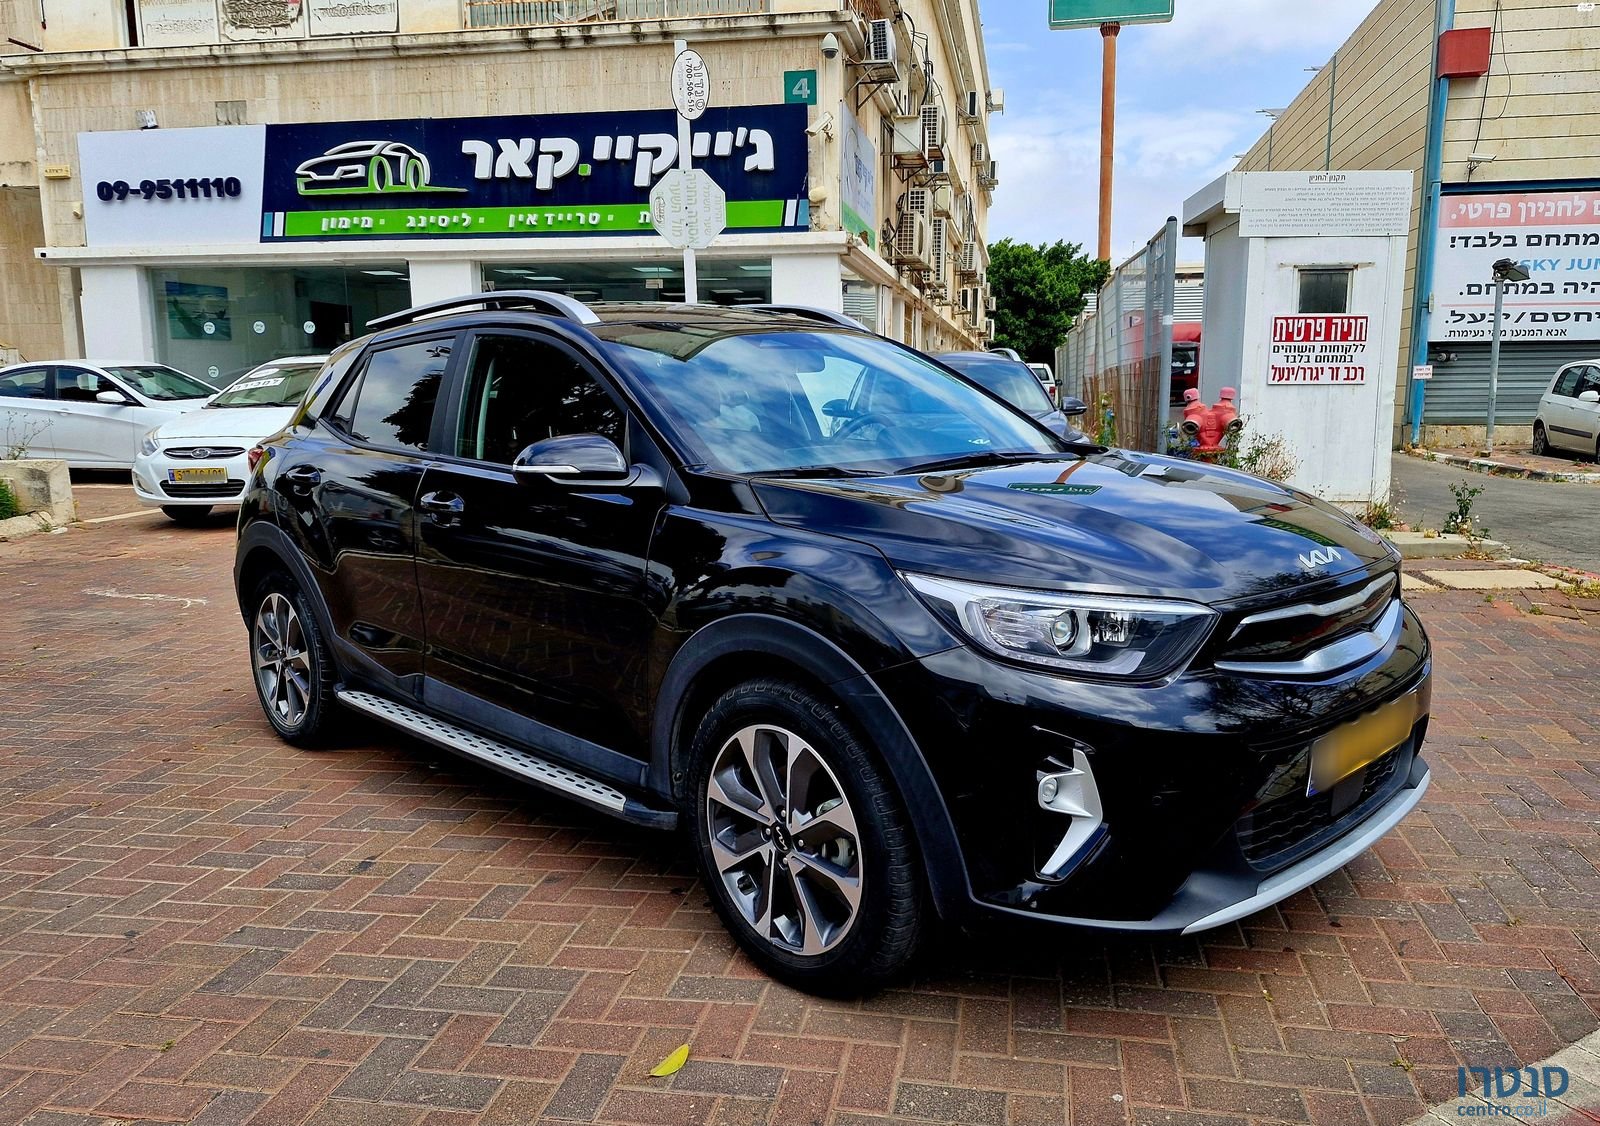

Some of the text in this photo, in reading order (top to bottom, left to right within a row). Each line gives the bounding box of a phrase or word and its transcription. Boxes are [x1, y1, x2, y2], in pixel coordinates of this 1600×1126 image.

[685, 57, 695, 112] 1-700-506-516
[792, 77, 811, 99] 4
[96, 176, 242, 202] 09-9511110
[685, 173, 699, 244] אסורה החניה
[1450, 201, 1512, 220] פרטי.
[1518, 195, 1587, 222] לחניון
[321, 212, 601, 232] טרייד אין ליסינג מימון
[1449, 231, 1518, 249] בלבד!
[1519, 258, 1561, 271] SKY
[1274, 318, 1367, 342] חניה פרטית
[1444, 329, 1485, 338] נעימות.
[1487, 329, 1507, 337] מי
[1546, 328, 1568, 337] אנא
[1272, 343, 1366, 355] ללקוחות השוהים
[1283, 353, 1354, 364] במתחם בלבד
[1271, 364, 1365, 383] רכב זר יגרר/ינעל
